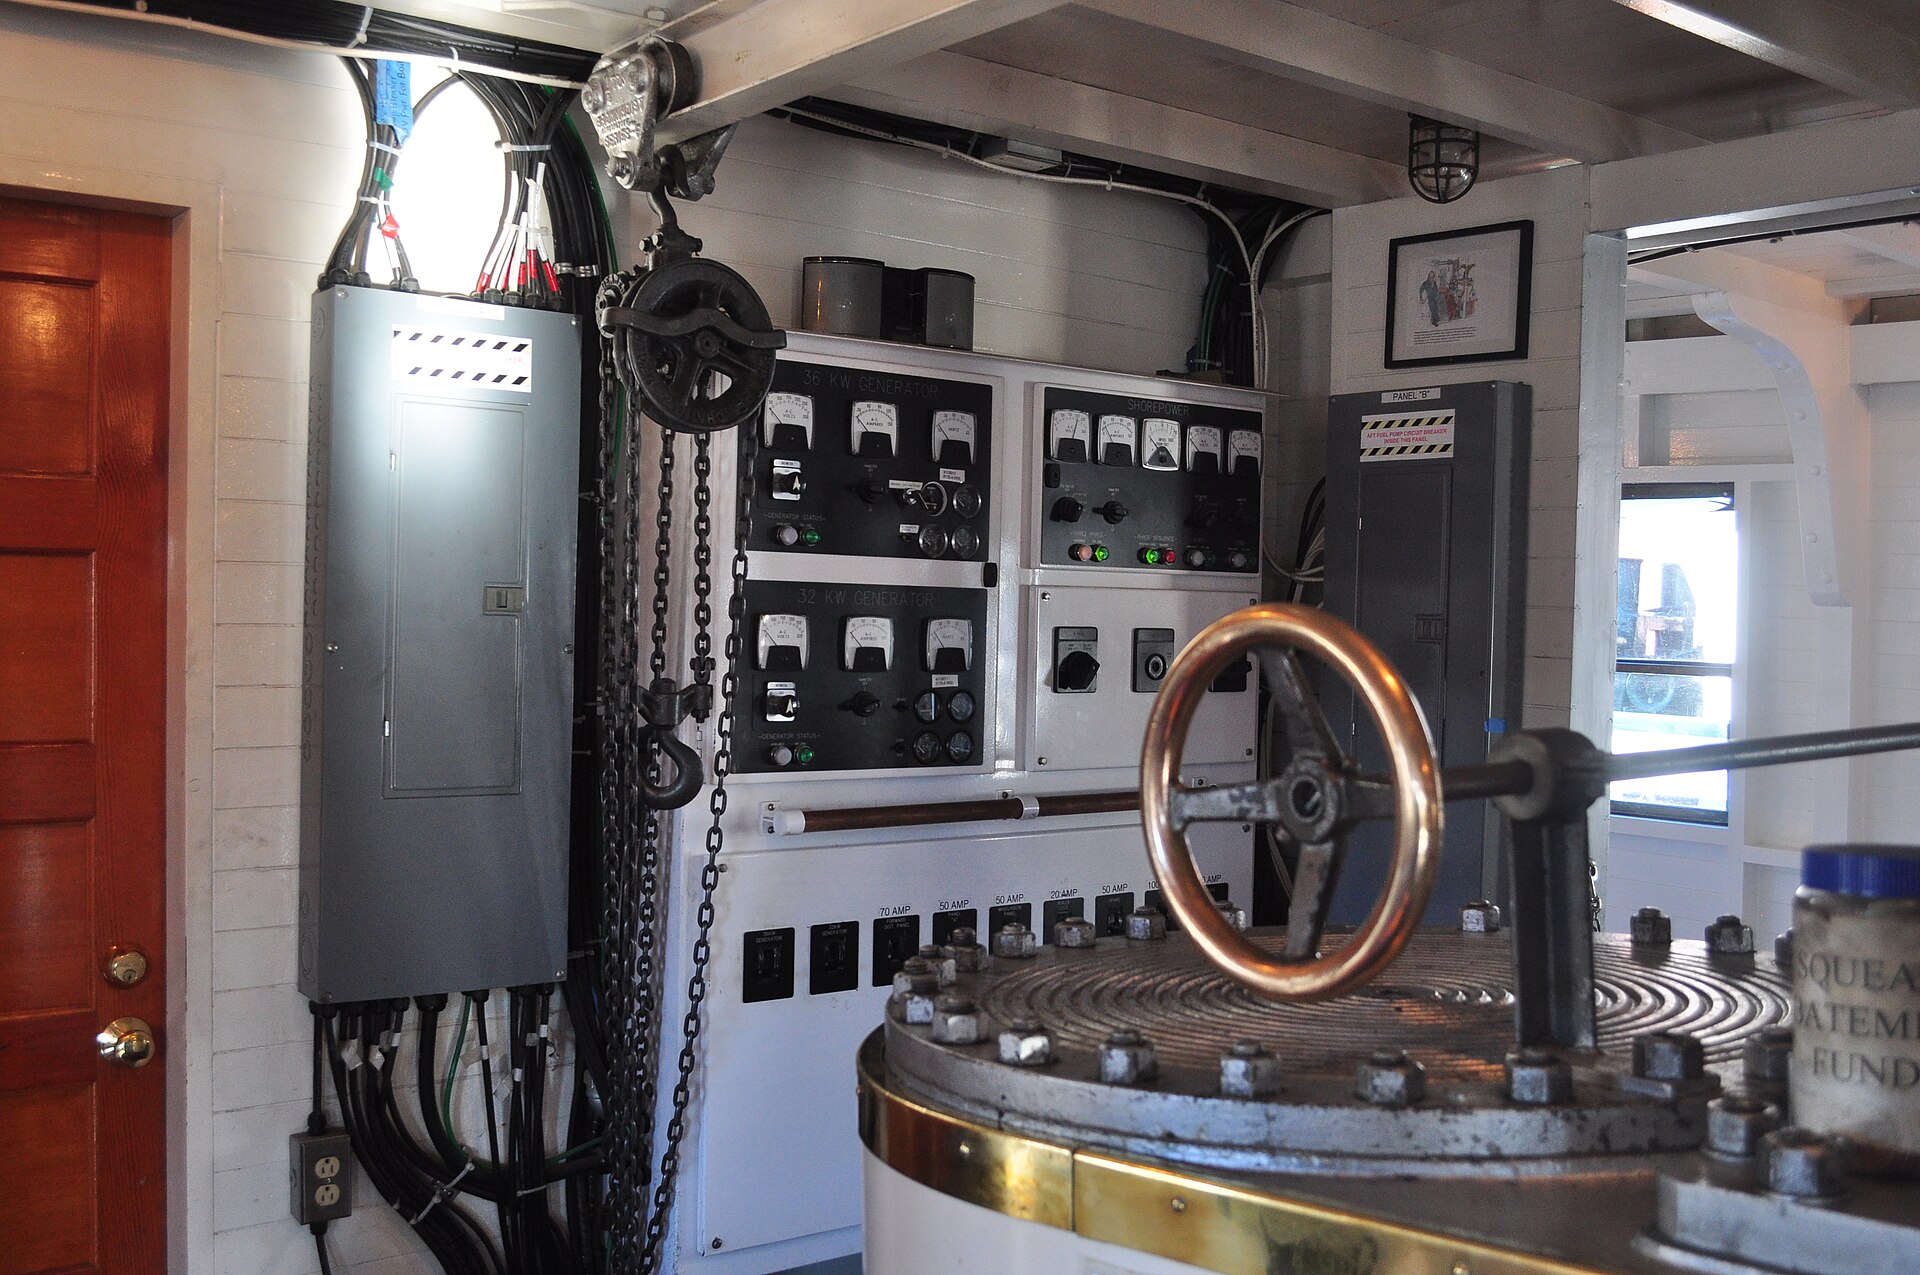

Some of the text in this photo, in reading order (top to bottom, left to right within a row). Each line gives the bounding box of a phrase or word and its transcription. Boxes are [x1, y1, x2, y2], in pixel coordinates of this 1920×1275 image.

[803, 371, 938, 399] 36 KW GENERATOR
[1393, 390, 1430, 401] PANEL "B"
[1127, 399, 1190, 417] SHOREPOWER
[799, 588, 934, 607] 32 KW GENERATOR
[1205, 874, 1222, 883] AMP
[1050, 888, 1078, 899] 20 AMP
[1101, 883, 1129, 894] 50 AMP
[995, 893, 1024, 904] 50 AMP
[880, 905, 911, 917] 70 AMP
[939, 899, 970, 911] 50 AMP
[755, 935, 783, 943] GENERATOR
[1797, 1000, 1920, 1040] ATEM
[1813, 1047, 1920, 1088] FUND
